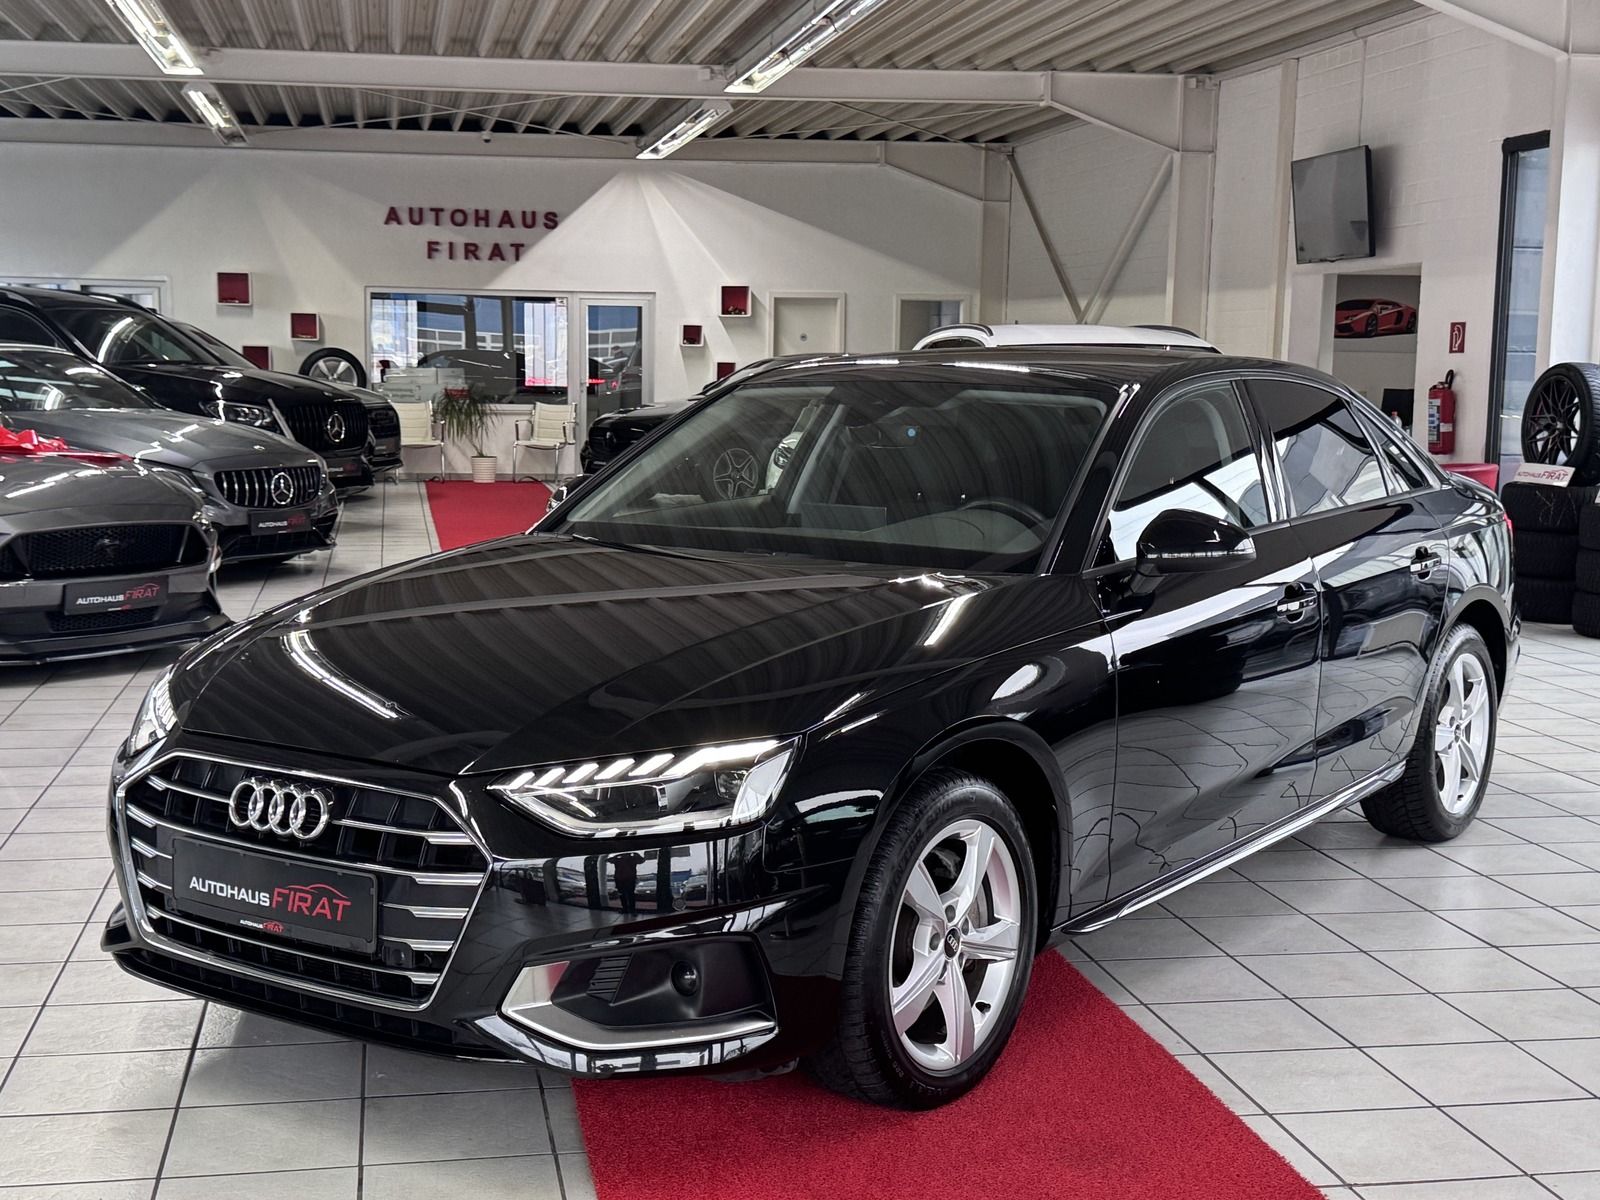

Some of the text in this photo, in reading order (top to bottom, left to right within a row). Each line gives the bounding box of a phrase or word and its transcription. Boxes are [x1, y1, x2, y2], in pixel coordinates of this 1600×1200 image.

[384, 206, 559, 230] AUTOHAUS
[426, 241, 526, 262] FIRAT
[76, 594, 125, 605] AUTOHAUS
[189, 876, 352, 922] AUTOHAUS FIRAT
